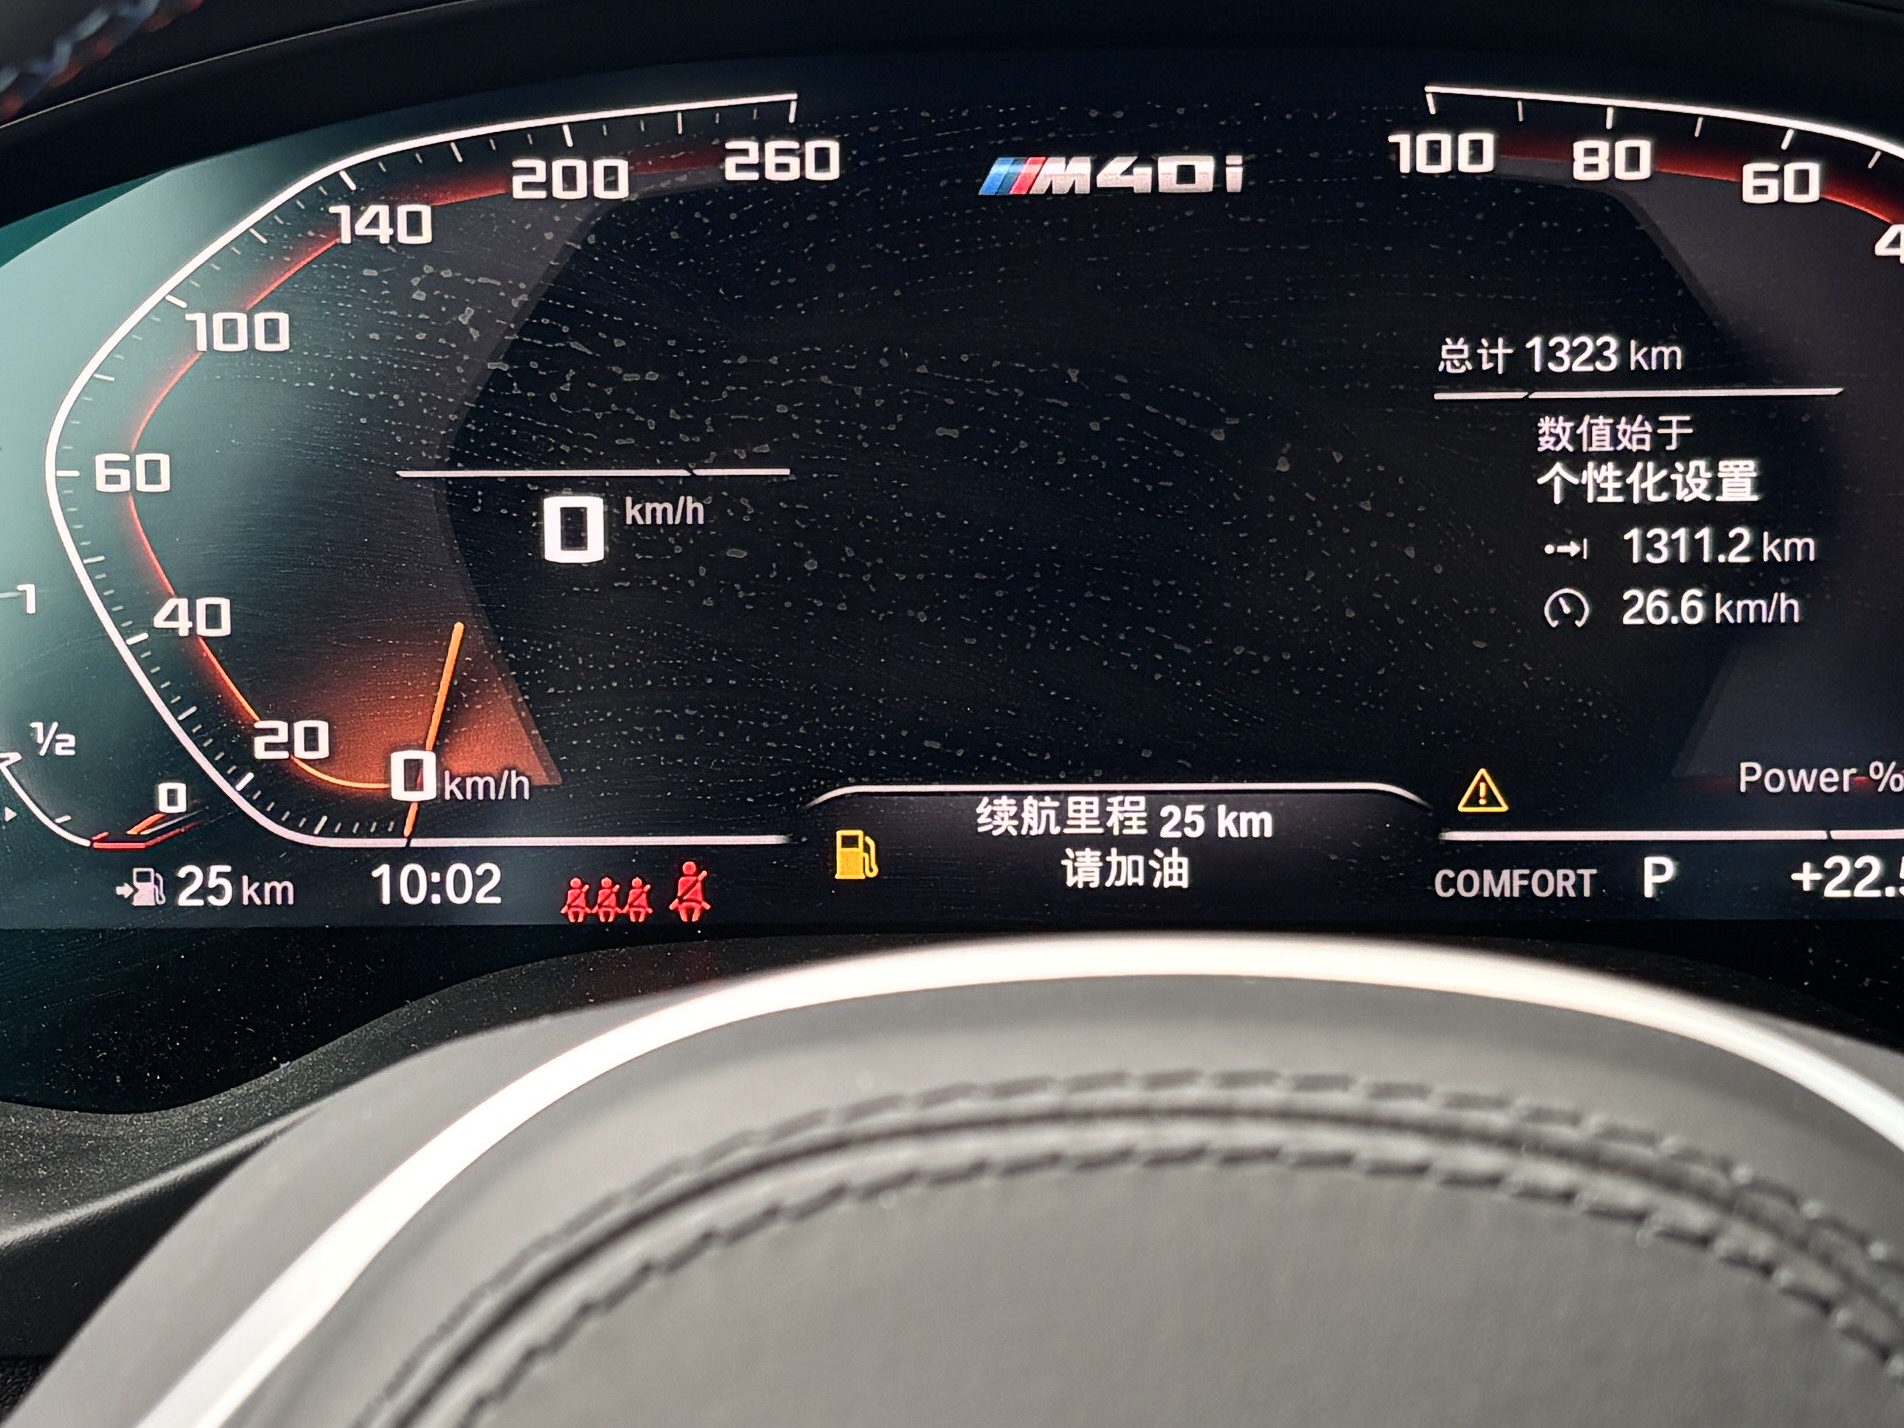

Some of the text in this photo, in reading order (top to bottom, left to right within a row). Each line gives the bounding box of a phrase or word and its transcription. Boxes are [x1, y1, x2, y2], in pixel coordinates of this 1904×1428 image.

[724, 139, 840, 182] 260
[1387, 131, 1495, 174] 100
[1572, 138, 1652, 181] 80
[511, 158, 630, 200] 200
[1027, 155, 1244, 195] M40i
[1742, 161, 1821, 204] 60
[327, 203, 434, 247] 140
[184, 310, 291, 354] 100
[1438, 334, 1682, 375] 总计 1323 km
[1537, 414, 1694, 453] 数值始于
[94, 452, 171, 493] 60
[1536, 459, 1760, 505] 个性化设置
[543, 495, 705, 564] 0 km/h
[1623, 526, 1815, 564] 1311.2 km
[153, 596, 231, 637] 40
[1622, 588, 1800, 625] 26.6 km/h
[252, 718, 331, 762] 20
[387, 748, 531, 802] 0 km/h
[1739, 760, 1904, 793] Power %
[157, 782, 187, 814] 0
[975, 794, 1273, 839] 续航里程 25 km
[176, 864, 294, 907] 25 km
[371, 862, 502, 905] 10:02
[1060, 846, 1189, 889] 请加油
[1434, 868, 1598, 898] COMFORT
[1643, 855, 1677, 898] P
